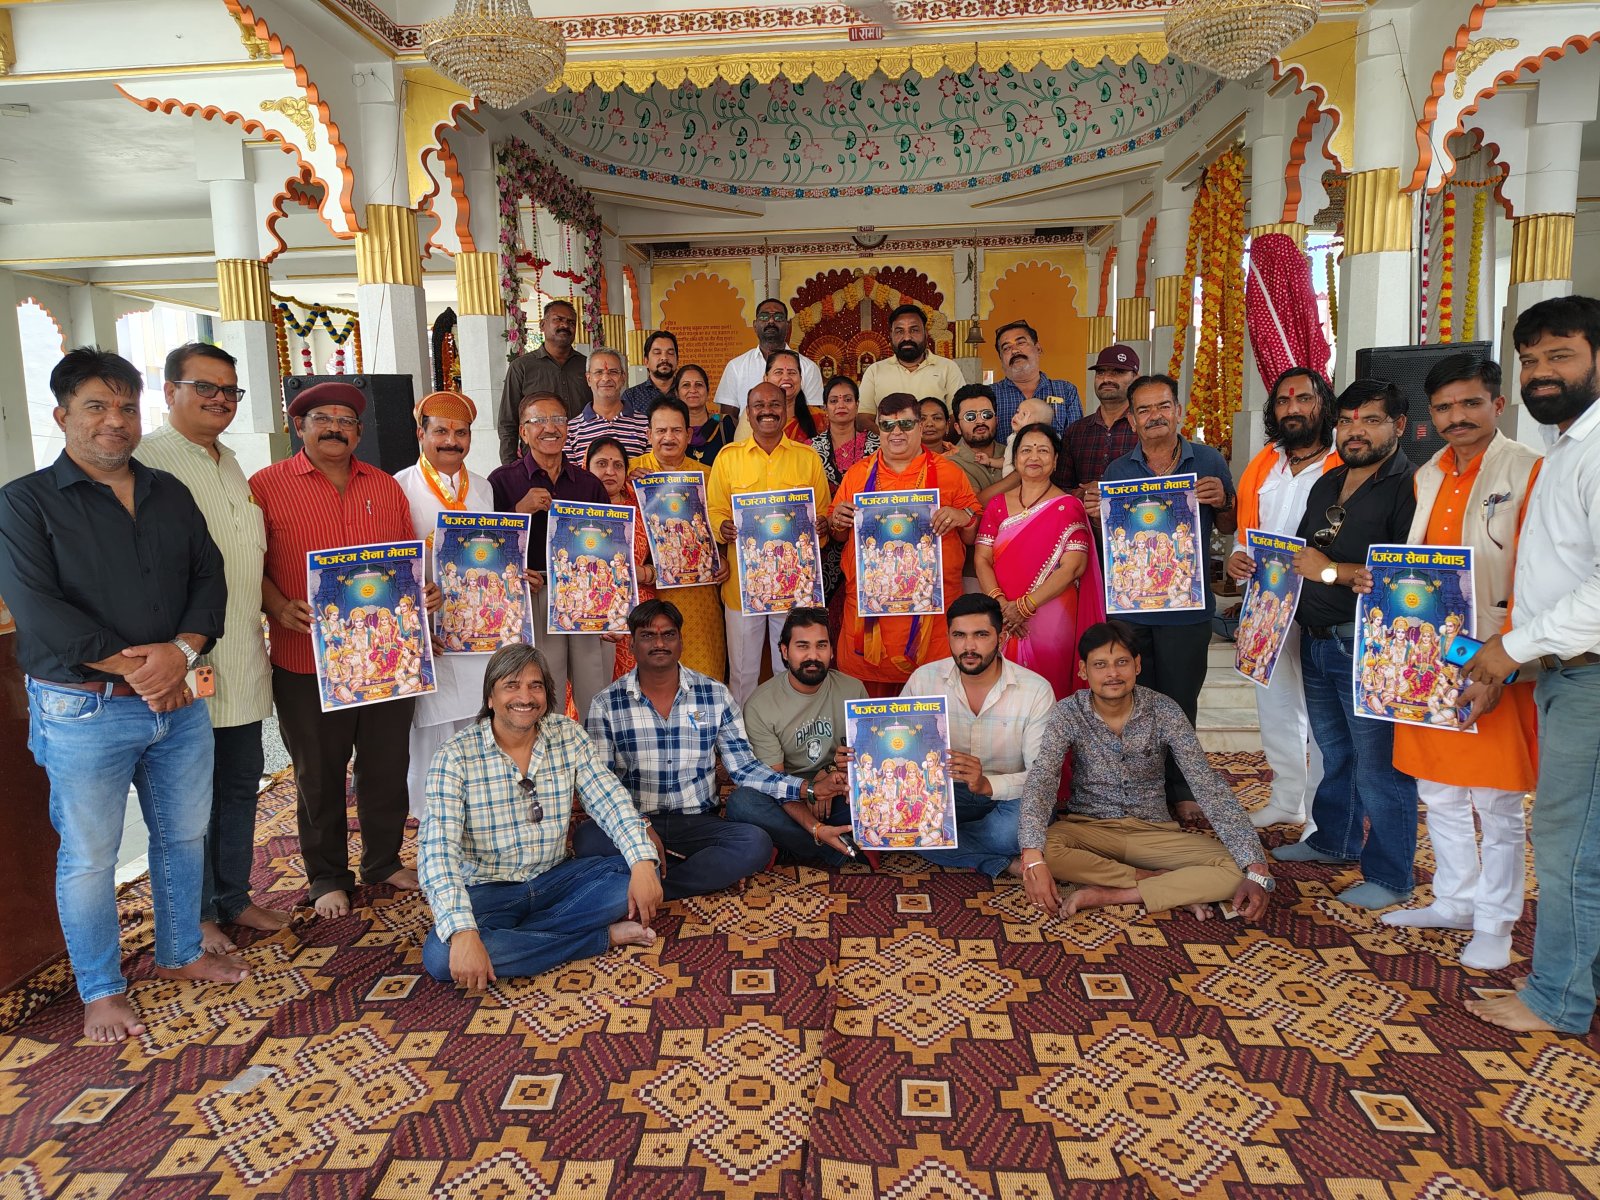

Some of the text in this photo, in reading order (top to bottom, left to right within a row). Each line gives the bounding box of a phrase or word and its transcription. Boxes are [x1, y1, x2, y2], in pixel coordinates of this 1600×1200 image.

[1140, 482, 1161, 492] सेना
[768, 495, 786, 504] सेना
[890, 495, 909, 504] सेना
[586, 507, 605, 517] सेना
[478, 515, 498, 527] सेना
[360, 550, 385, 561] सेना
[1405, 551, 1430, 564] सेना
[889, 702, 911, 713] सेना
